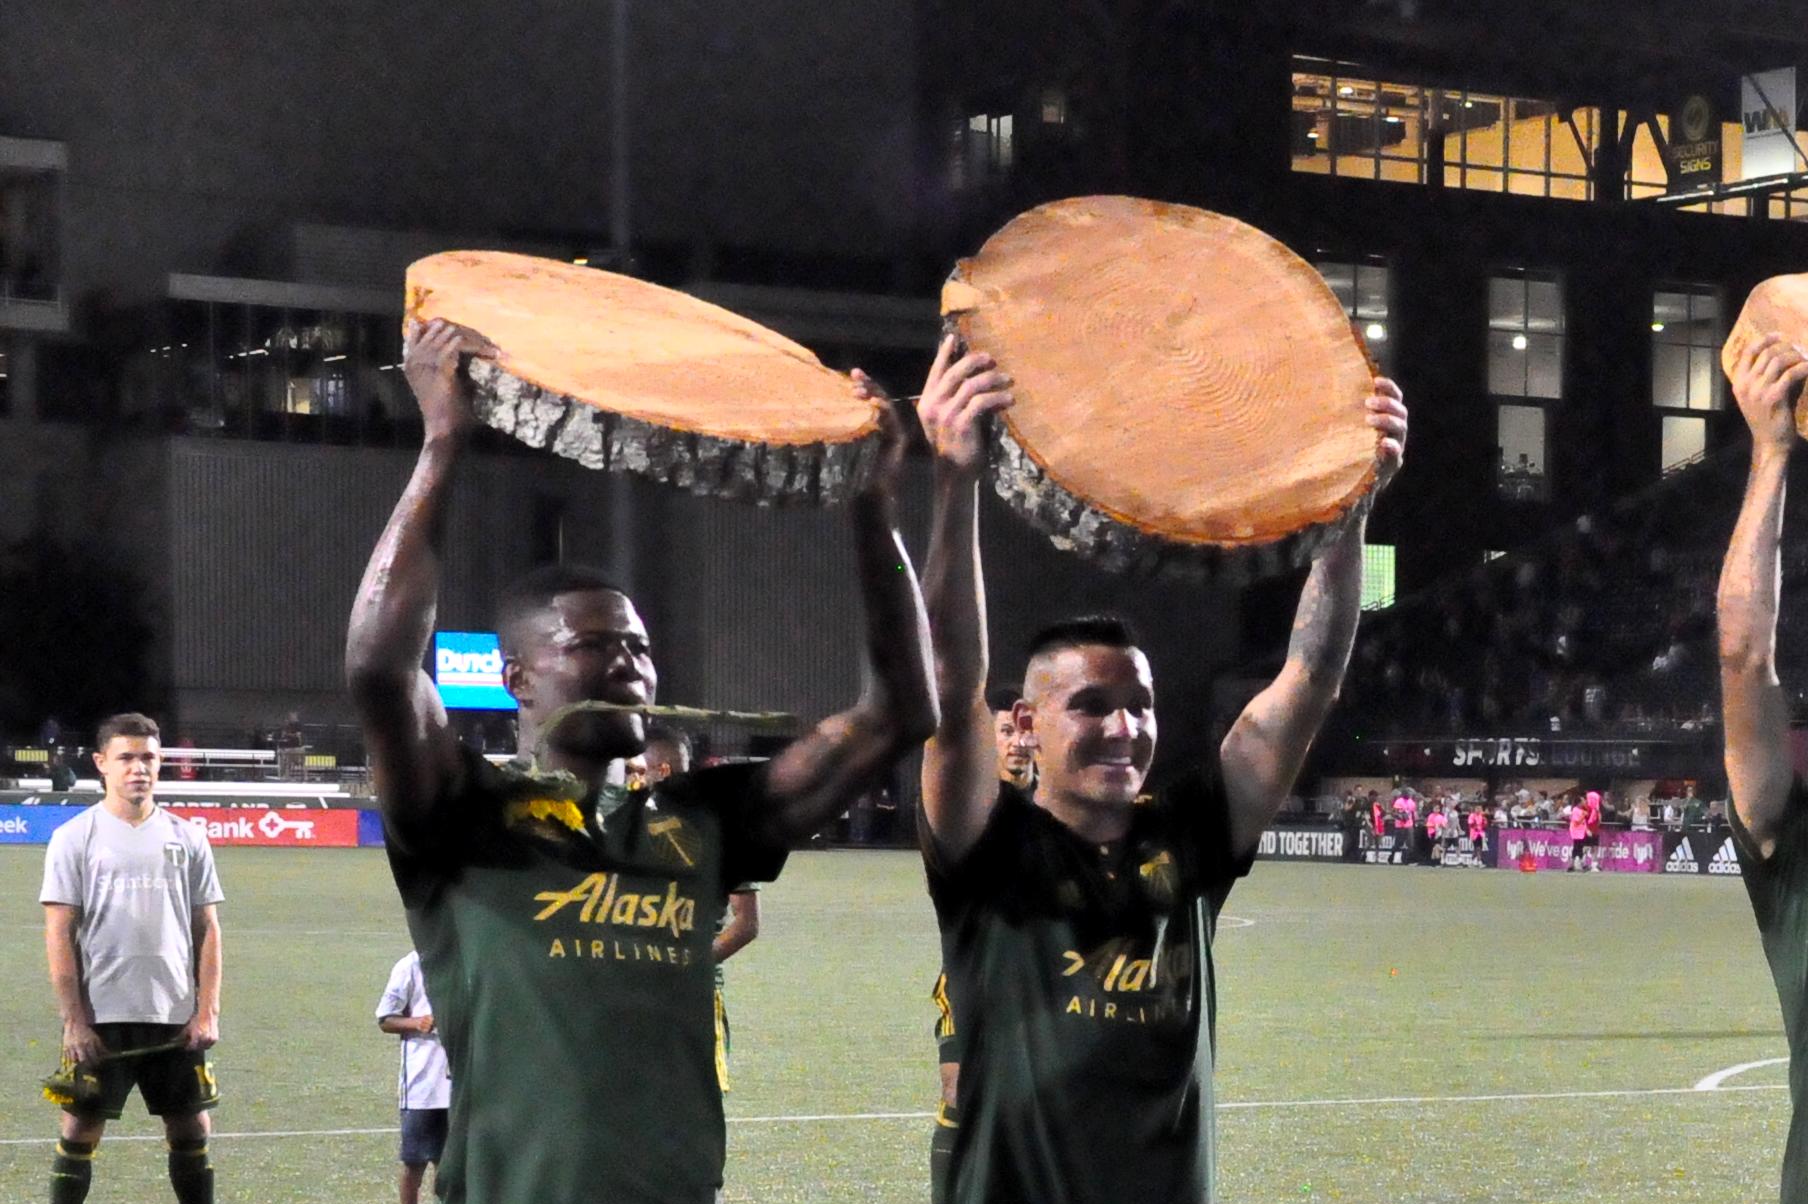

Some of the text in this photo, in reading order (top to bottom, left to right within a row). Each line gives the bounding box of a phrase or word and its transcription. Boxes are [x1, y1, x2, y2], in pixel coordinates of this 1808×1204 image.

[1680, 158, 1711, 174] SIGNS
[1453, 738, 1541, 766] SPORTS
[1278, 832, 1343, 856] TOGETHER
[1665, 861, 1699, 873] adidas
[533, 872, 696, 938] Alaska
[550, 938, 691, 965] AIRLINES
